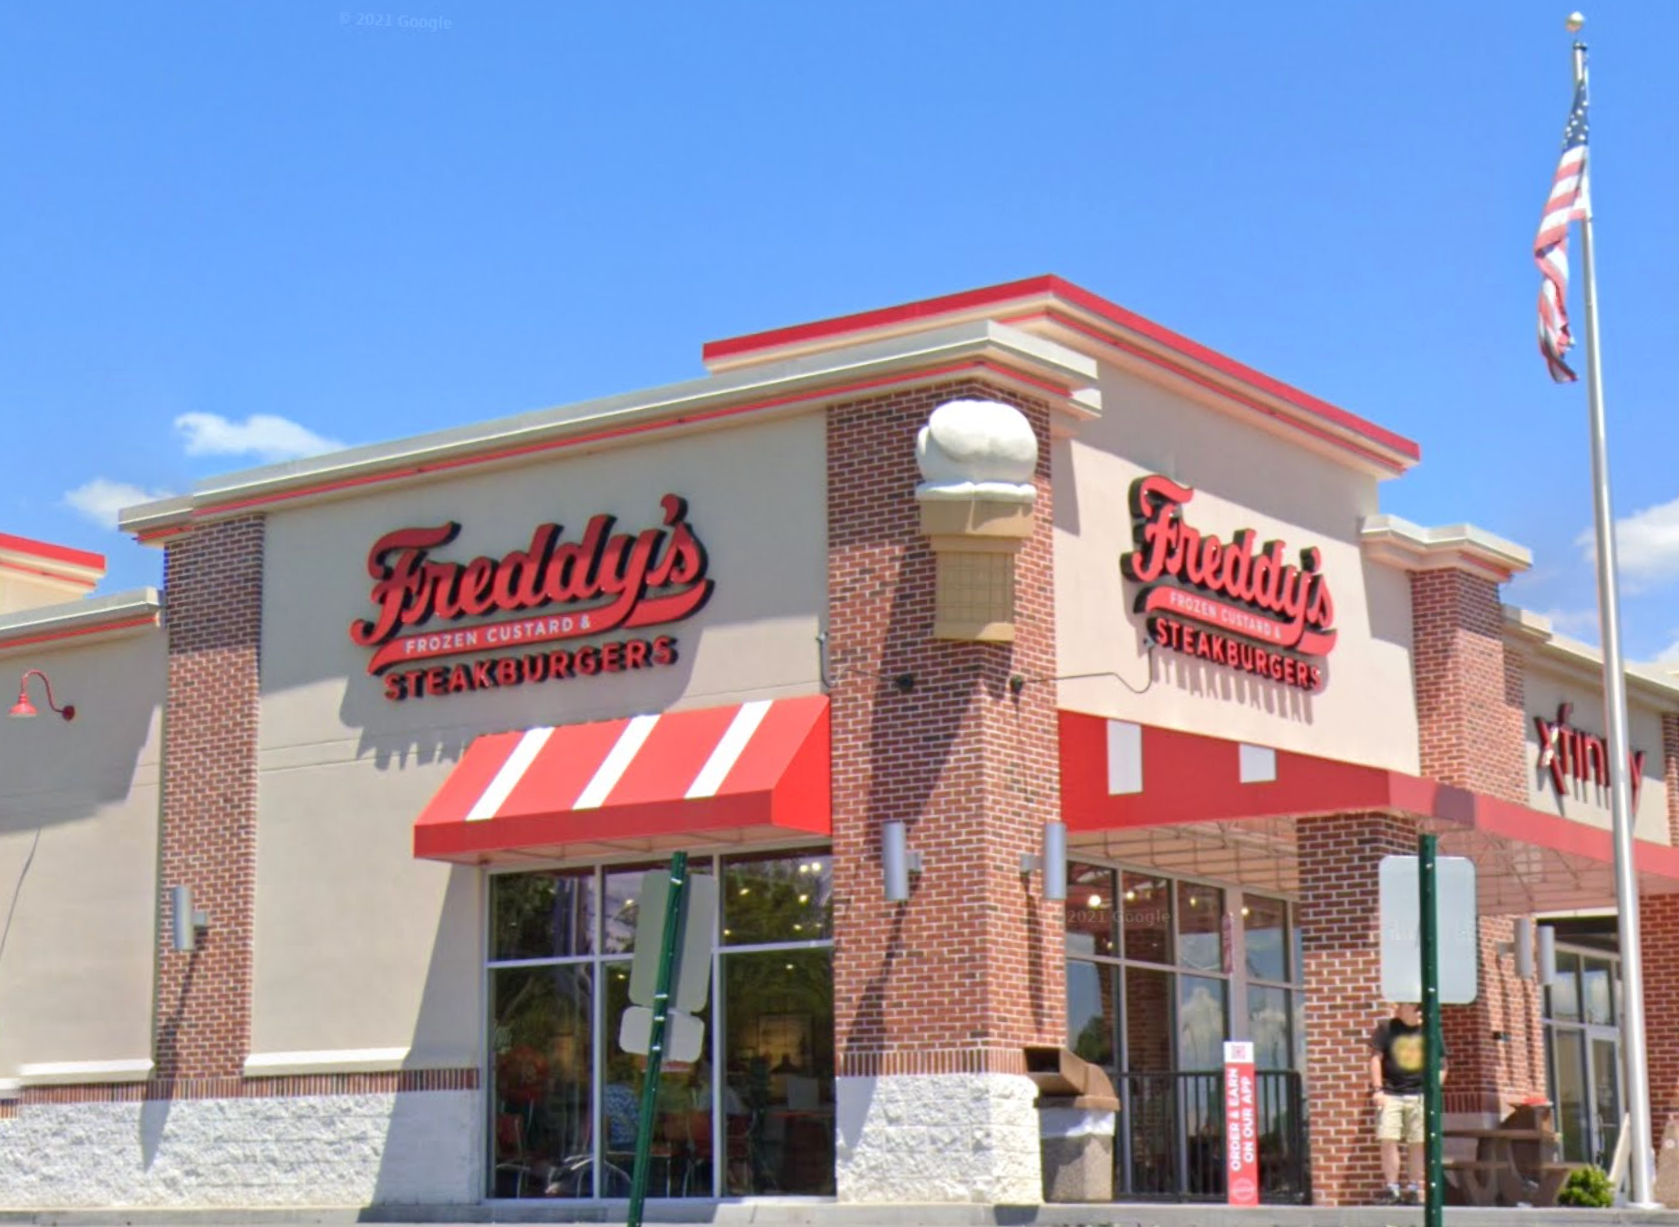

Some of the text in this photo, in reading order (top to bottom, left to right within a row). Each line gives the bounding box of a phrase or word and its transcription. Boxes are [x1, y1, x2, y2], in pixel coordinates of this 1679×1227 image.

[348, 493, 714, 675] Freddy's
[1119, 474, 1337, 656] Freddy's
[405, 614, 591, 655] FROZEN CUSTARD &
[1169, 590, 1217, 618] FROZEN
[1221, 608, 1271, 636] CUSTARD
[384, 635, 678, 702] STEAKBURGERS
[1147, 617, 1323, 690] STEAKBURGERS
[1228, 1068, 1240, 1107] EARN
[1241, 1076, 1254, 1163] ON OUR APP
[1229, 1123, 1242, 1172] ORDER
